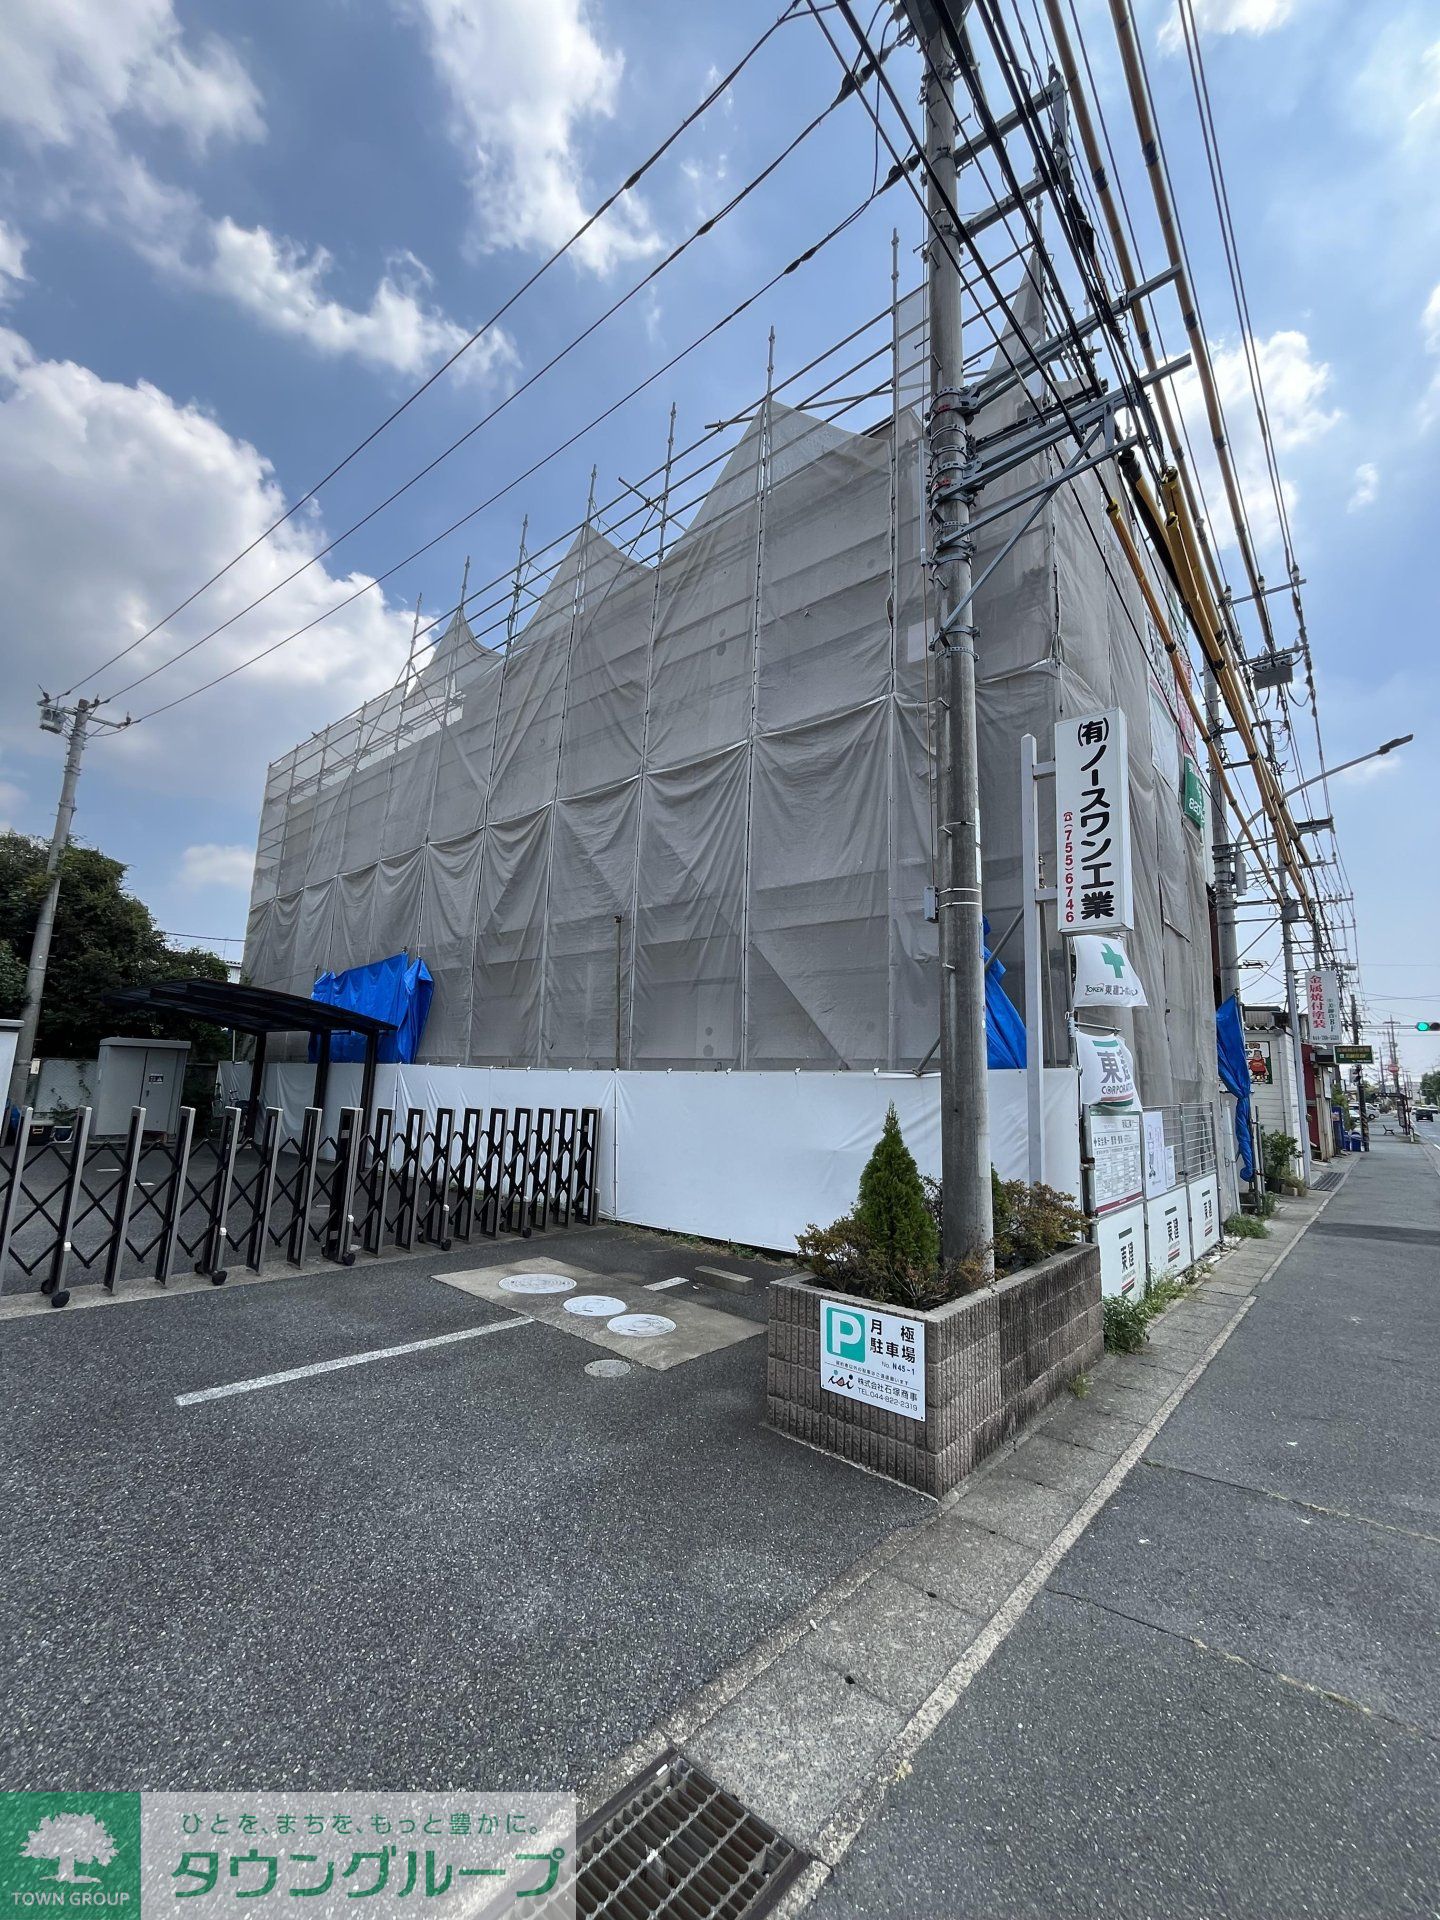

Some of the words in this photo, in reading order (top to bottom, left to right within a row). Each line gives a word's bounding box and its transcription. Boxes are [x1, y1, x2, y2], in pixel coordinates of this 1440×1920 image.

[1077, 717, 1115, 920] (有)ノースワン工業
[869, 1336, 916, 1364] 駐車場
[857, 1377, 918, 1402] 株式会社石塚商事
